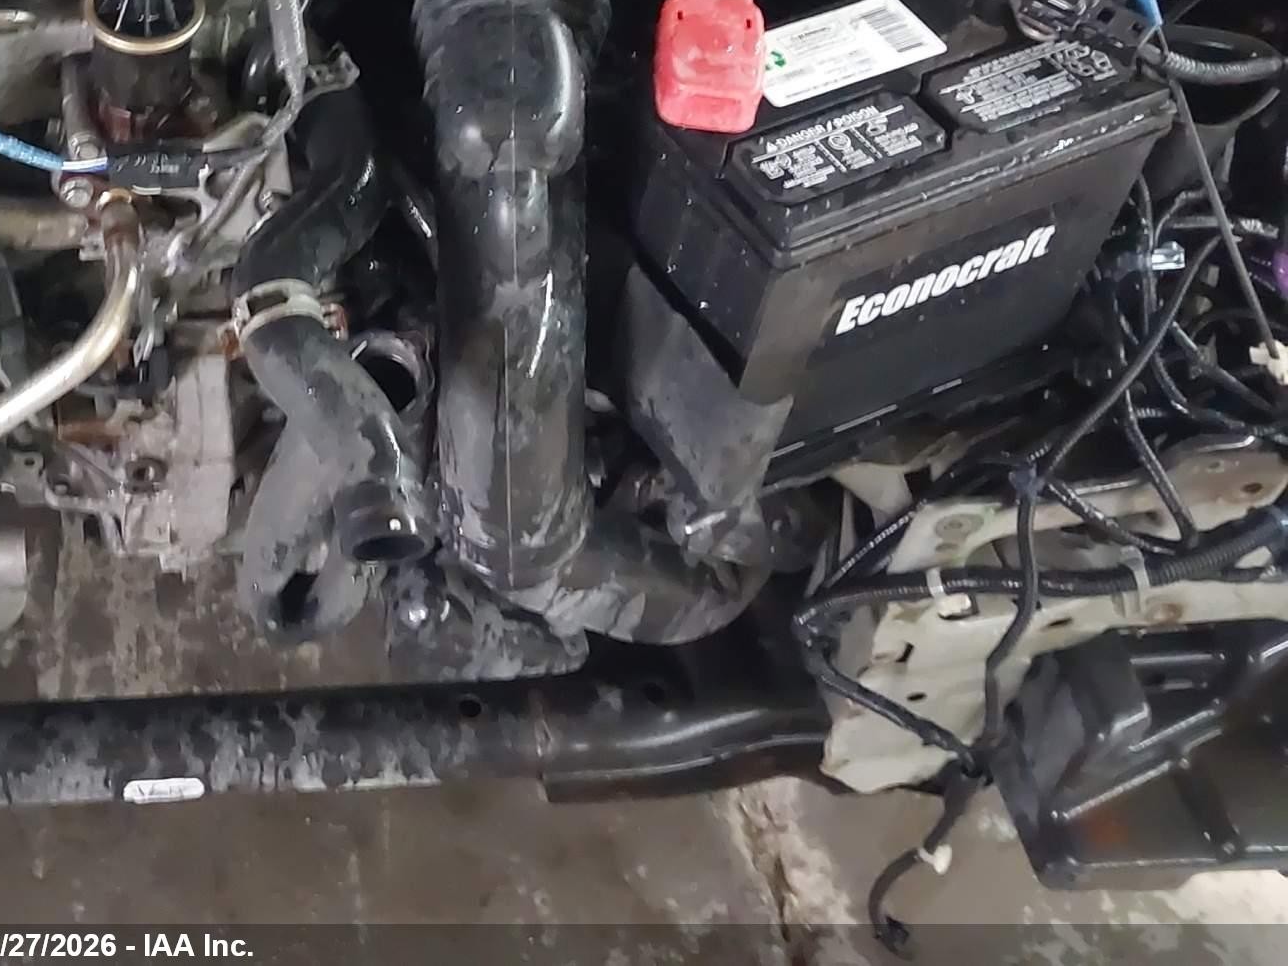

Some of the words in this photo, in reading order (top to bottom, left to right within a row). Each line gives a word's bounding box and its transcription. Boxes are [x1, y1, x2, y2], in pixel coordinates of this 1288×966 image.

[775, 124, 827, 148] DANGER
[832, 105, 880, 129] POISON
[834, 224, 1056, 336] Econocraft
